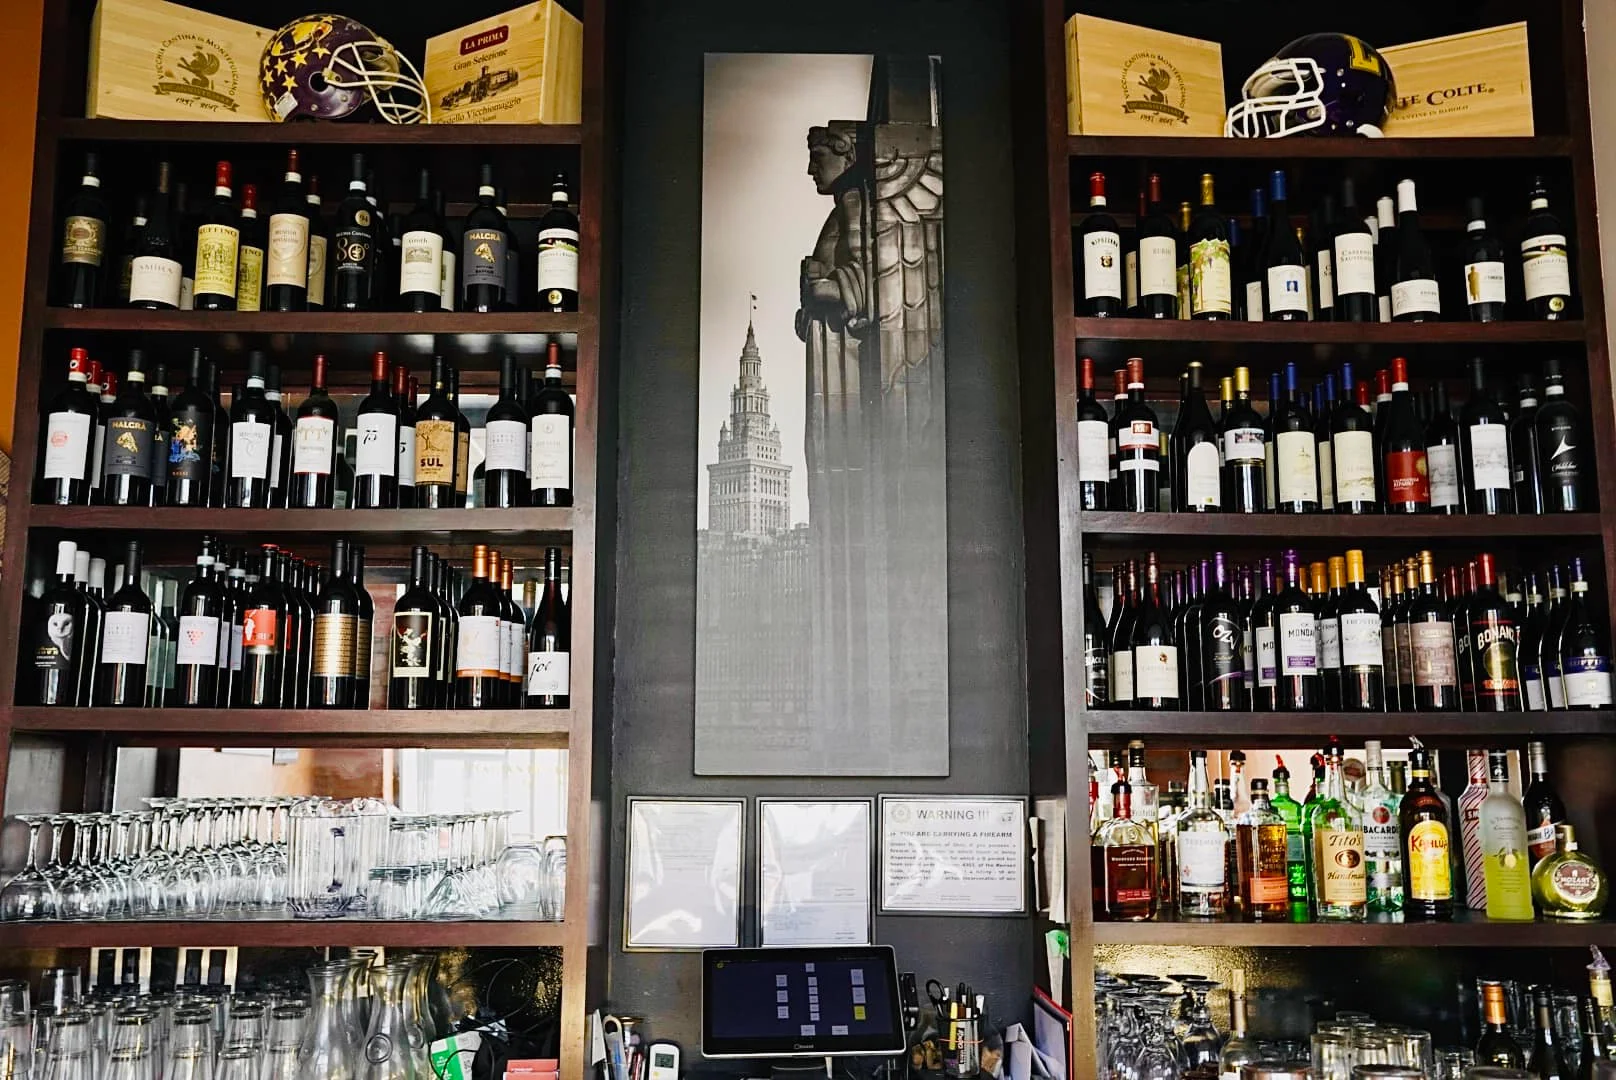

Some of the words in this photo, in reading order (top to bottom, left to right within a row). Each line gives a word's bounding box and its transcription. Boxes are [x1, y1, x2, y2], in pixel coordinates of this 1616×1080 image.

[161, 34, 196, 48] CANTINA
[465, 42, 475, 51] LA
[477, 31, 504, 47] PRIMA
[453, 60, 472, 71] Gran
[472, 48, 508, 65] Selezione
[1426, 82, 1489, 107] COLTE
[467, 97, 522, 120] Vicchiomaggio
[420, 457, 444, 468] SUL
[917, 809, 974, 821] WARNING
[980, 831, 1013, 839] FIREARM
